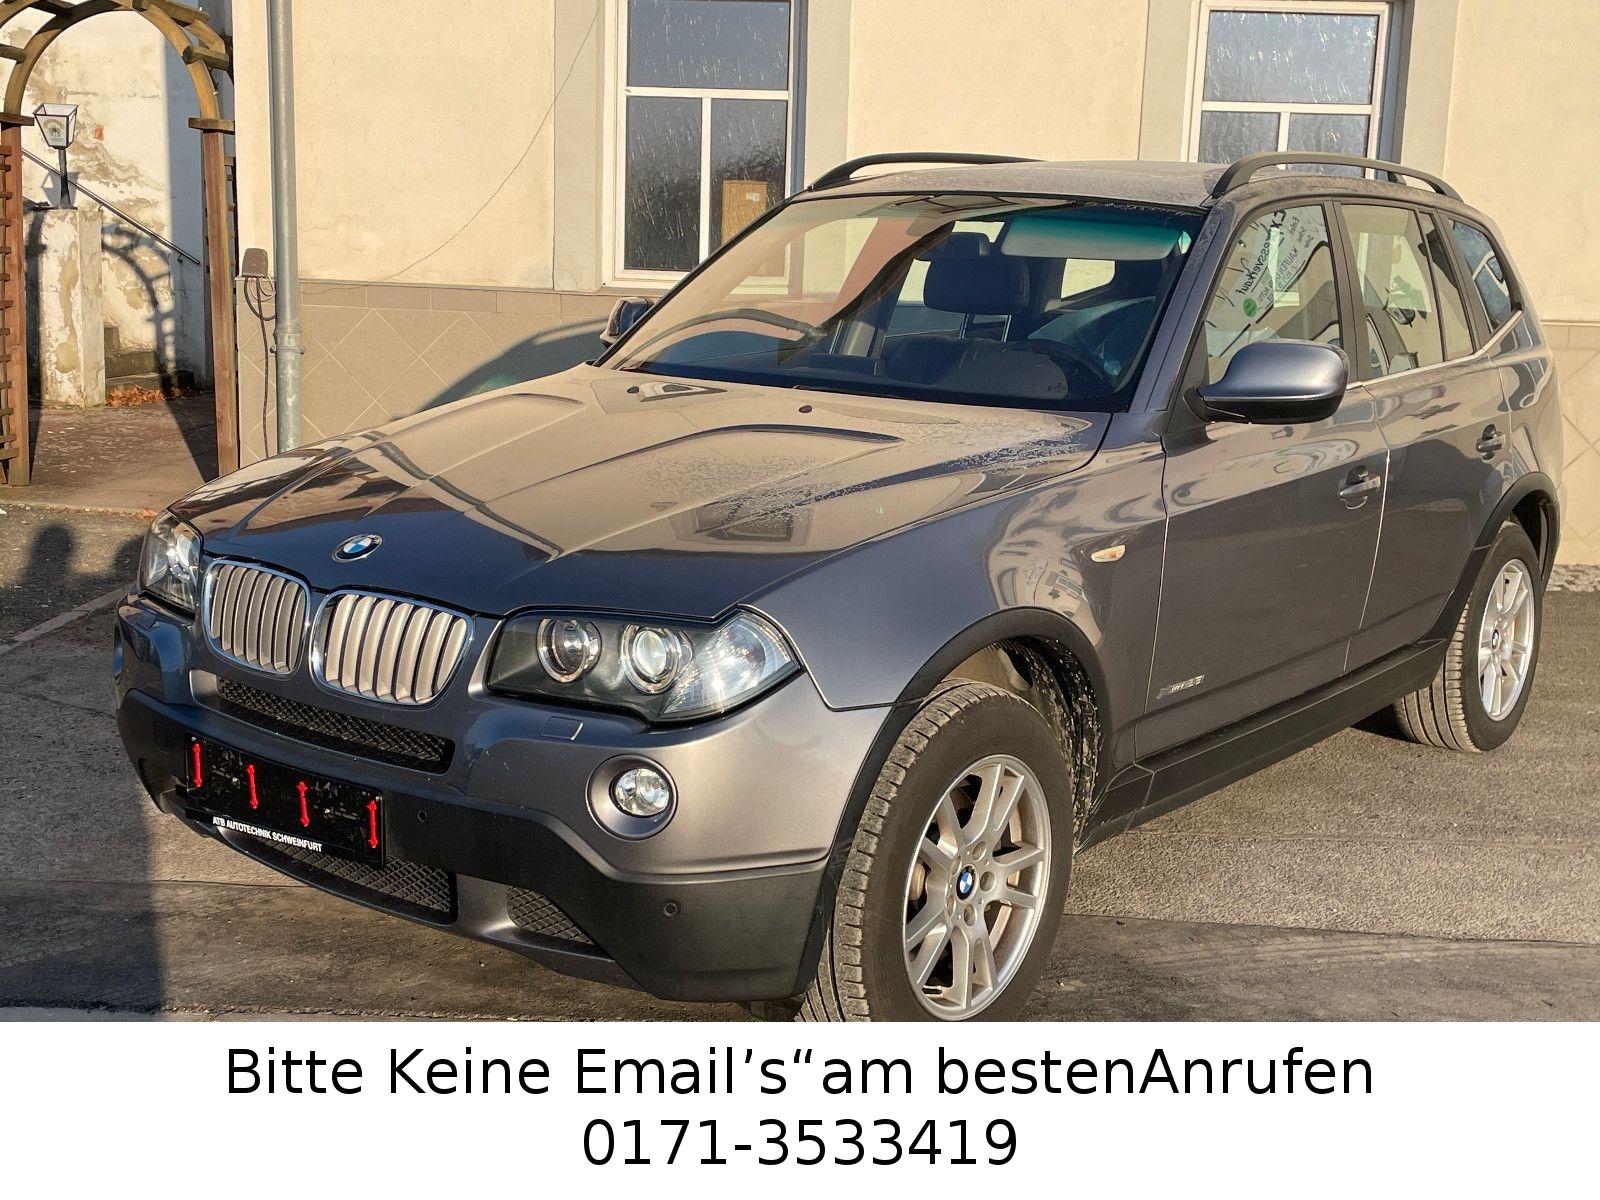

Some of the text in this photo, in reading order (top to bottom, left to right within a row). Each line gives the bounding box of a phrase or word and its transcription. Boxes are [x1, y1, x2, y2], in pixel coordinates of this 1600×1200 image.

[213, 816, 323, 853] ATB AUTOTECHNIK SCHWEINFURT
